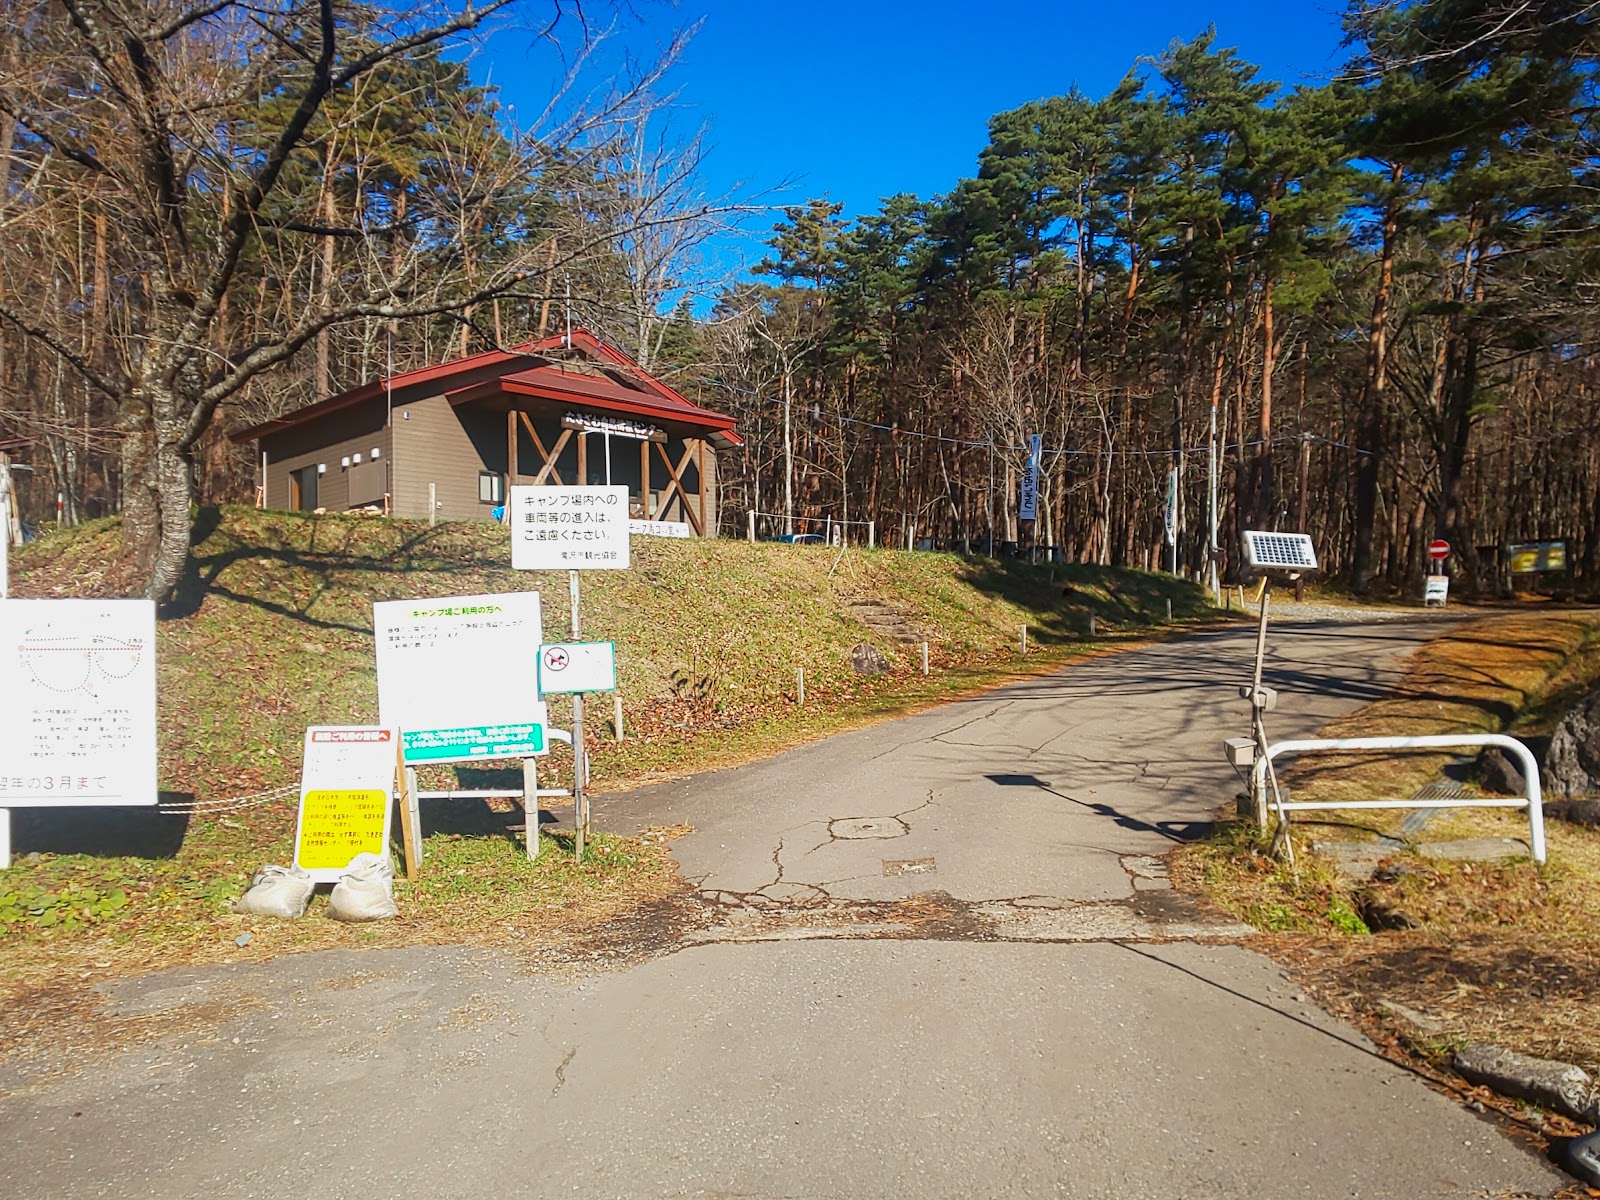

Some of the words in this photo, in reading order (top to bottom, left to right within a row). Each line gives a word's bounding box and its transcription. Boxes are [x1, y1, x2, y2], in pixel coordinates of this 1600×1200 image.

[524, 494, 618, 507] キャンプ場内への
[524, 512, 611, 524] 車両等の進入は、
[524, 529, 611, 541] ご遠慮ください。
[412, 605, 503, 617] キャンプ場ご利用の方へ
